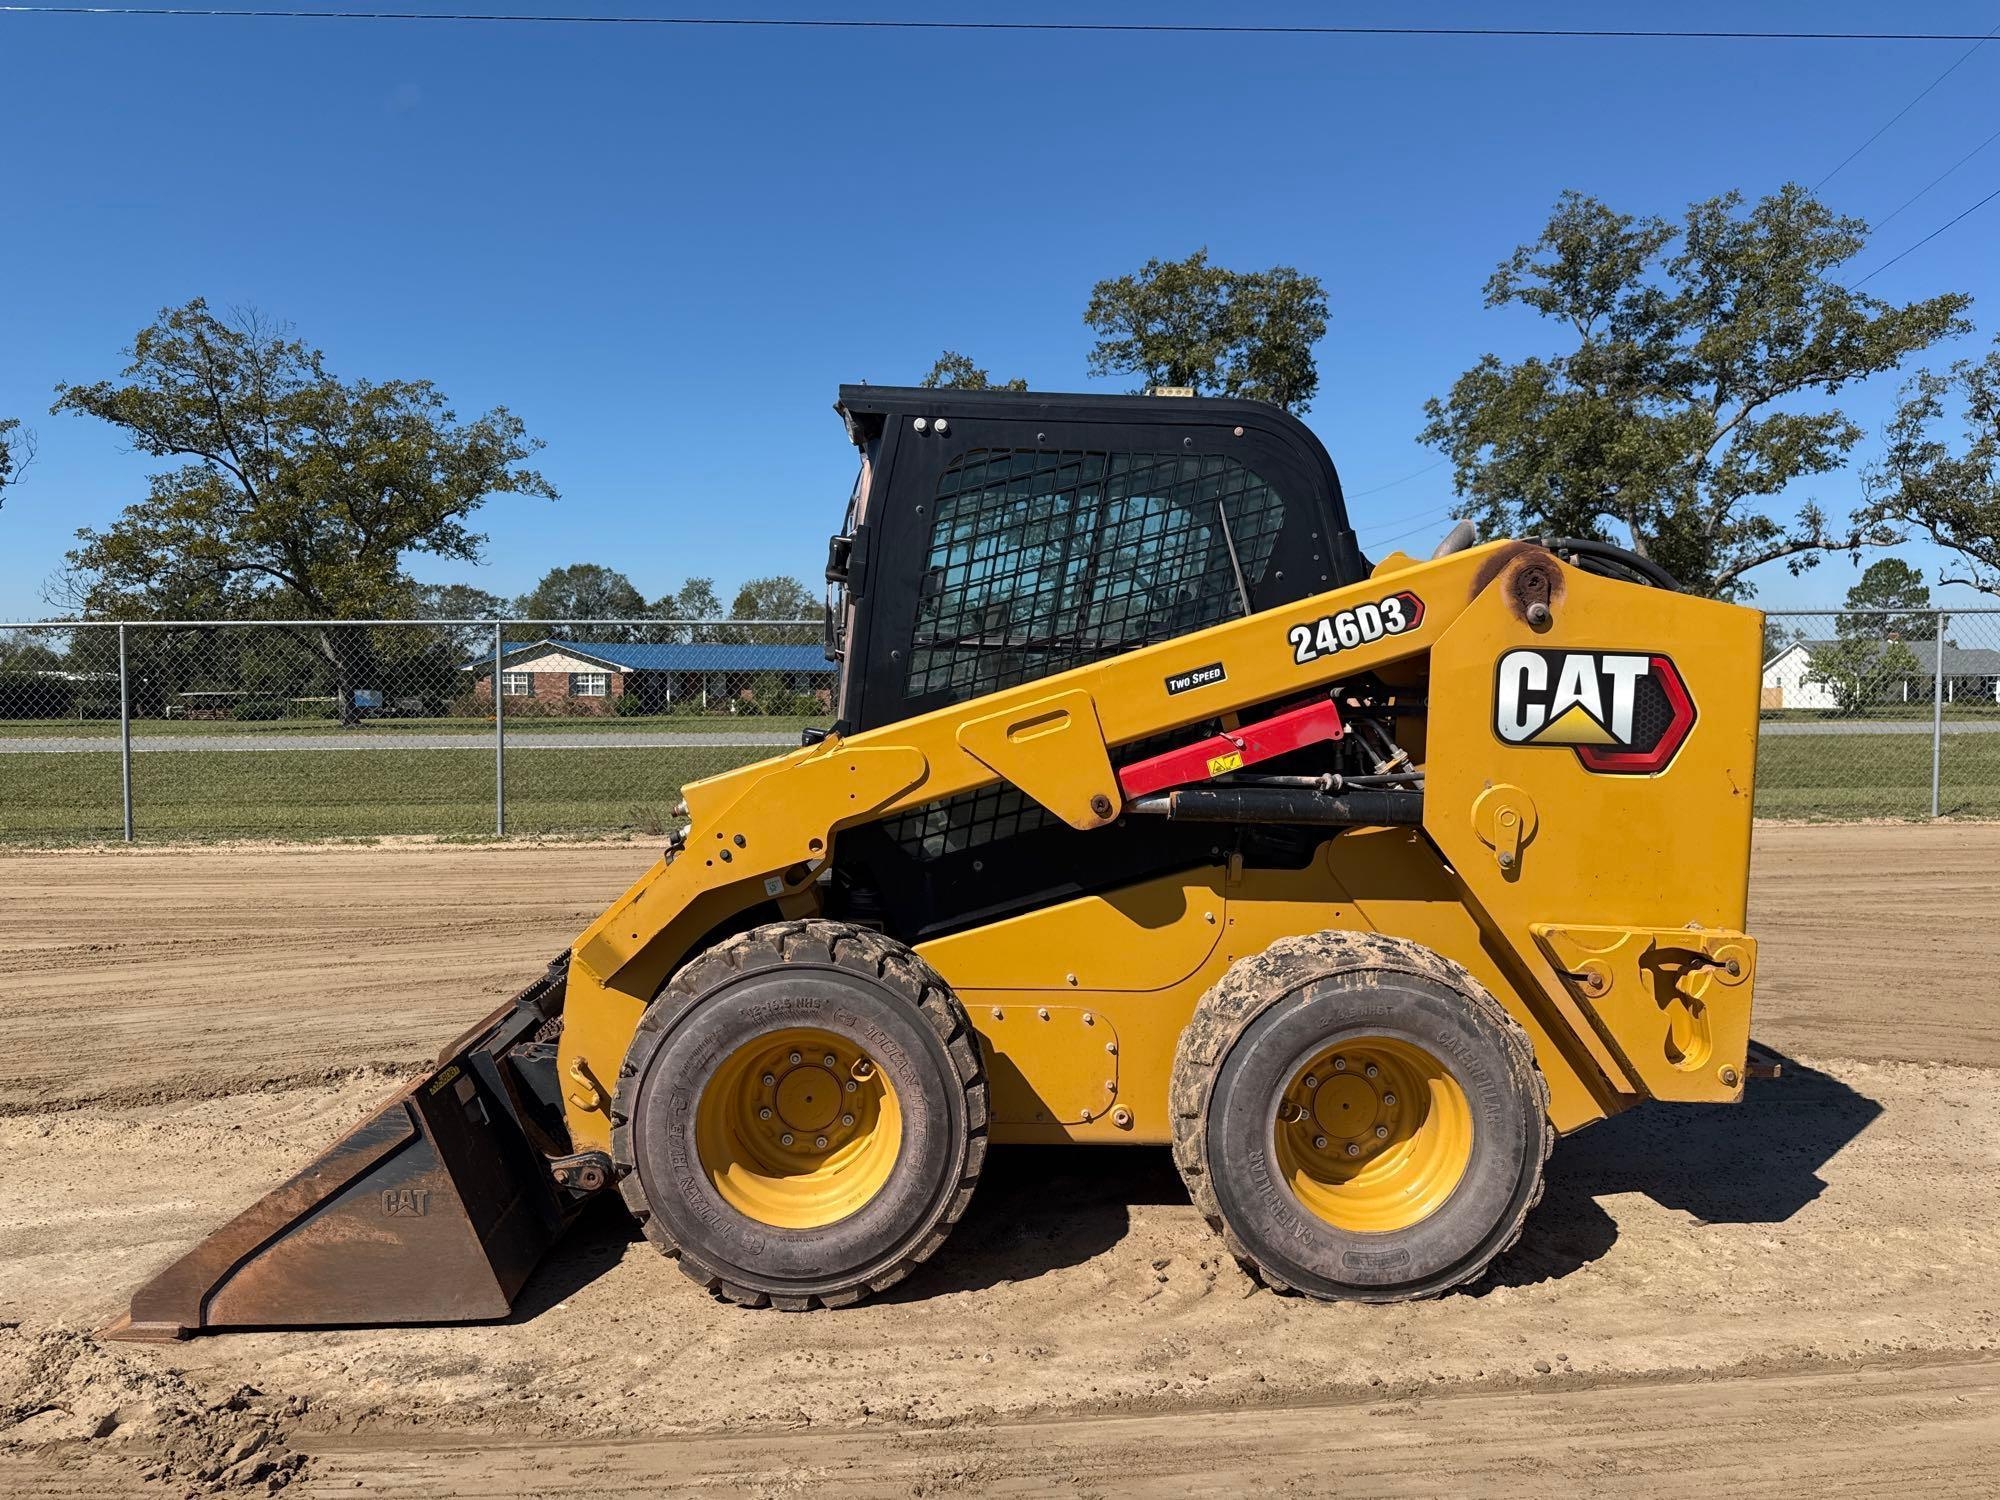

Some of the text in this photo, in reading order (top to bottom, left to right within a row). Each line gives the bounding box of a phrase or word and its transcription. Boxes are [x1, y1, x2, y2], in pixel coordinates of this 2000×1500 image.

[1289, 597, 1406, 662] 246D3
[1497, 651, 1650, 745] CAT
[1436, 1029, 1503, 1127] CATERPILLAR
[382, 1189, 429, 1217] CAT
[1248, 1148, 1315, 1246] CATERPILLAR
